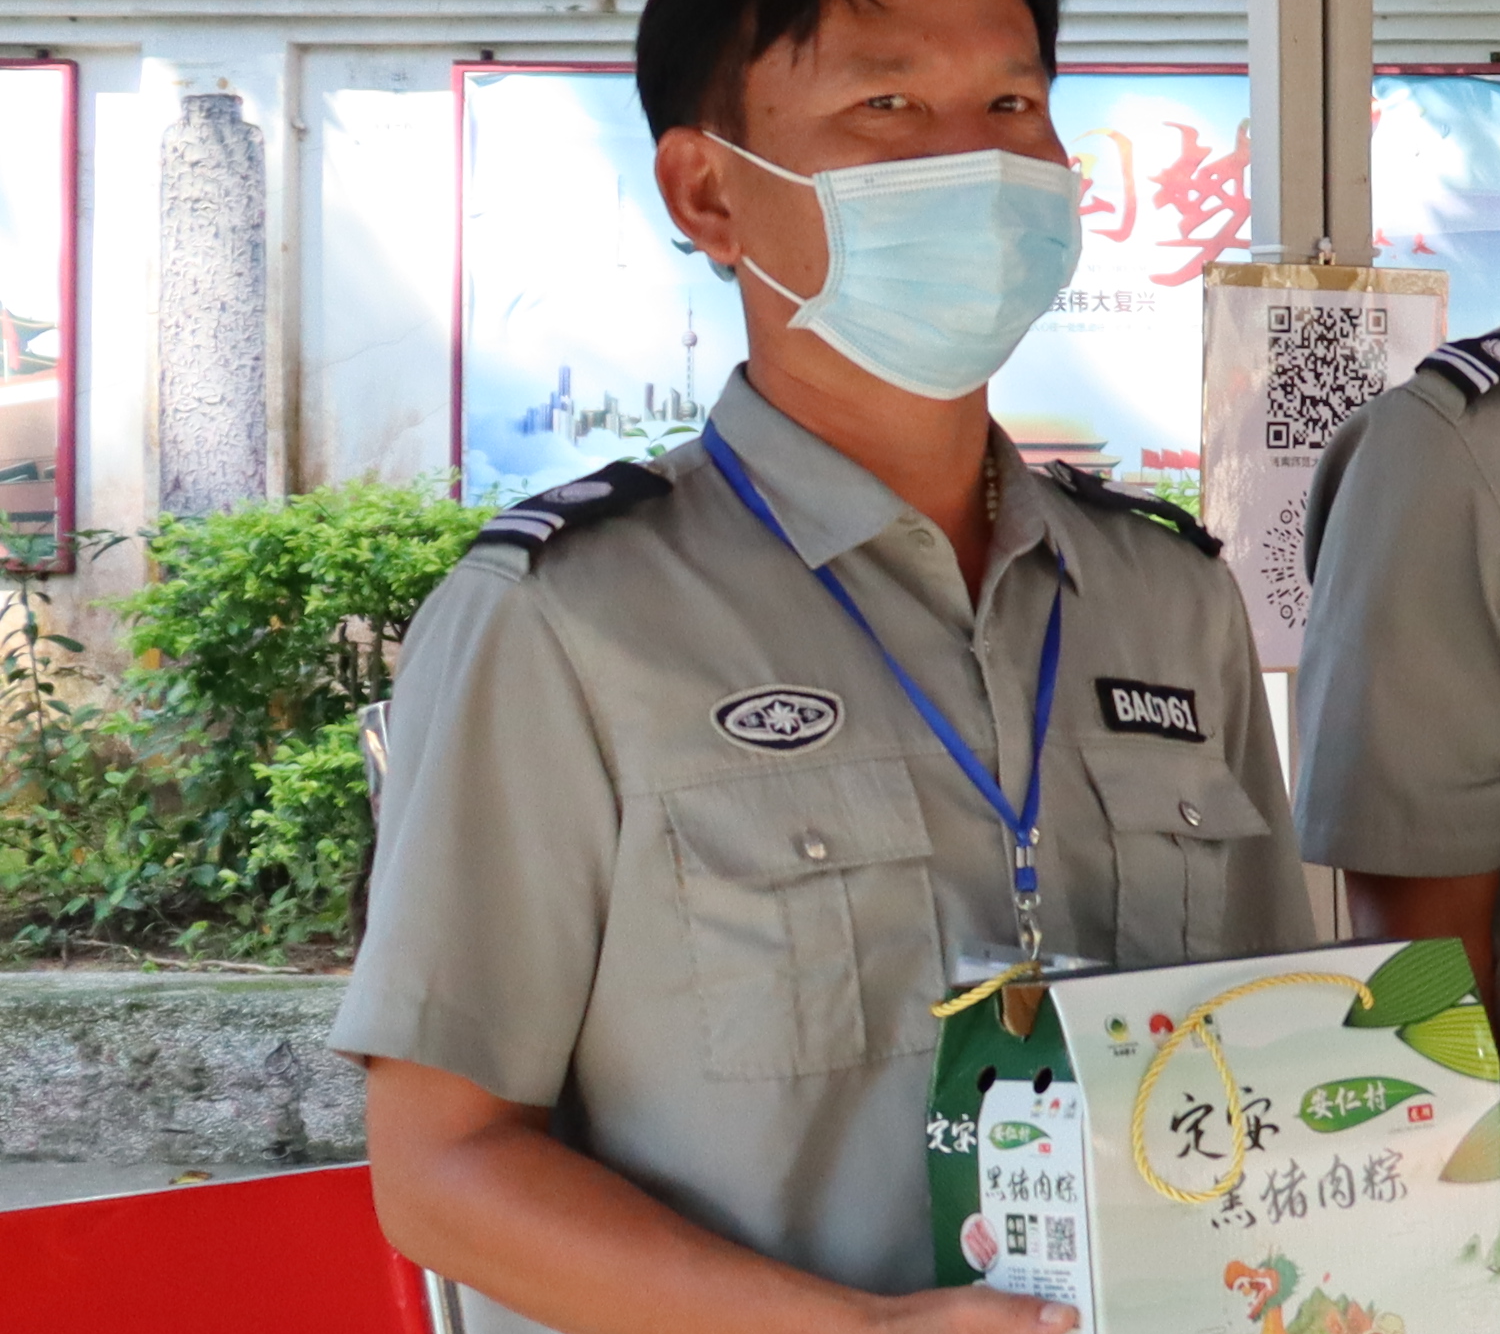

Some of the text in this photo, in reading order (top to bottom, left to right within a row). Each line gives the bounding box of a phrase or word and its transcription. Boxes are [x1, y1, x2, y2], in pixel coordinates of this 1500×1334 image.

[1170, 1085, 1281, 1160] 定安
[1306, 1080, 1388, 1120] 安仁村
